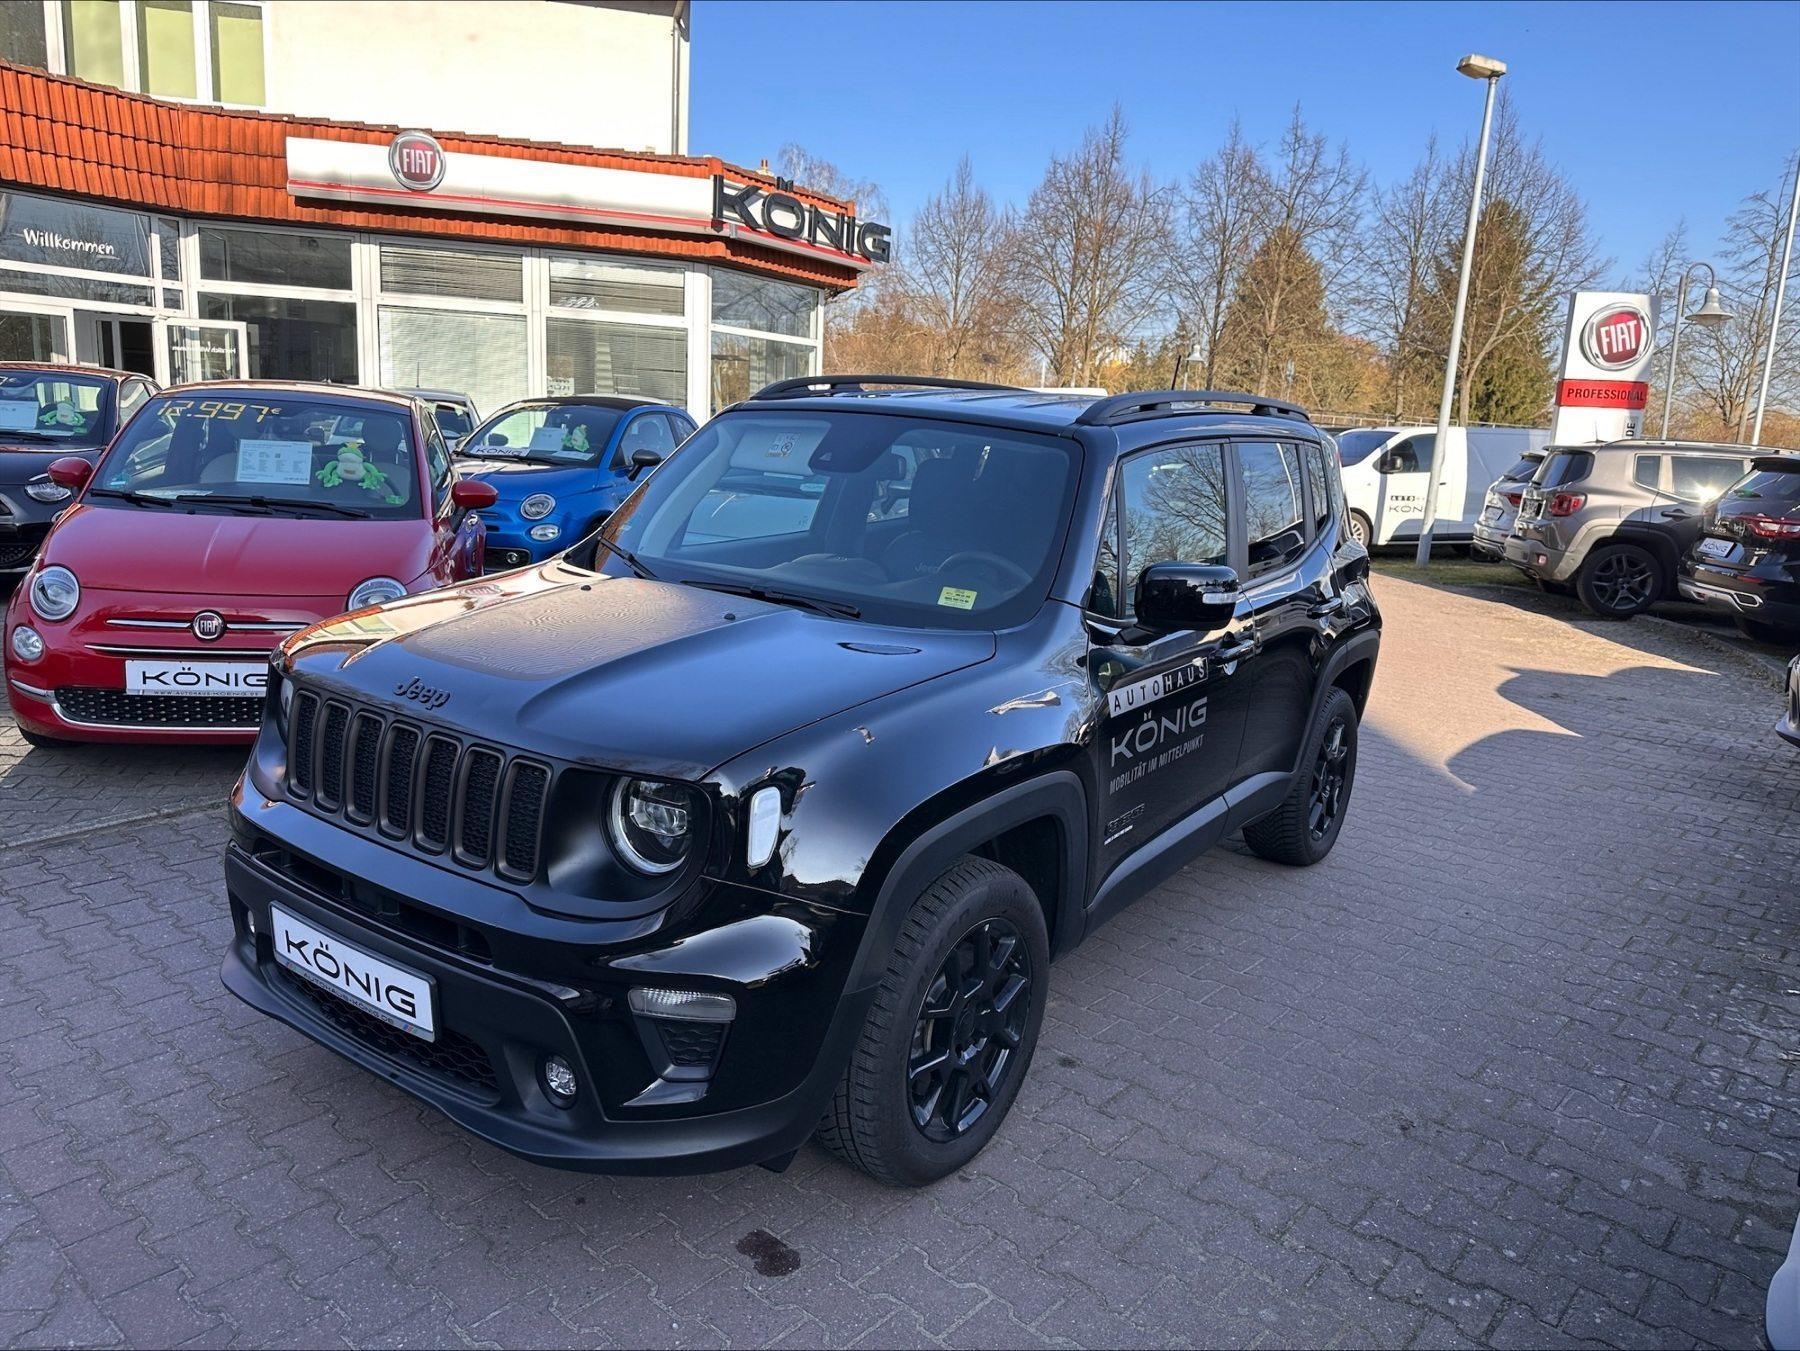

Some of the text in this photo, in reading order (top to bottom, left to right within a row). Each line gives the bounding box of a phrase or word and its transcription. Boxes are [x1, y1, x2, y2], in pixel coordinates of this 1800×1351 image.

[402, 148, 433, 174] FIAT
[713, 174, 892, 263] KÖNIG
[23, 228, 115, 255] Willkommen
[1600, 320, 1638, 355] FIAT
[1567, 387, 1645, 401] PROFESSIONAL
[200, 620, 218, 632] FIAT
[142, 666, 268, 687] KÖNIG
[393, 676, 451, 710] Jeep
[1113, 662, 1206, 712] AUTOHAUS
[1110, 696, 1208, 768] KÖNIG
[1109, 734, 1205, 796] MOBILITÄT IM MITTELPUNKT
[285, 929, 417, 1018] KÖNIG
